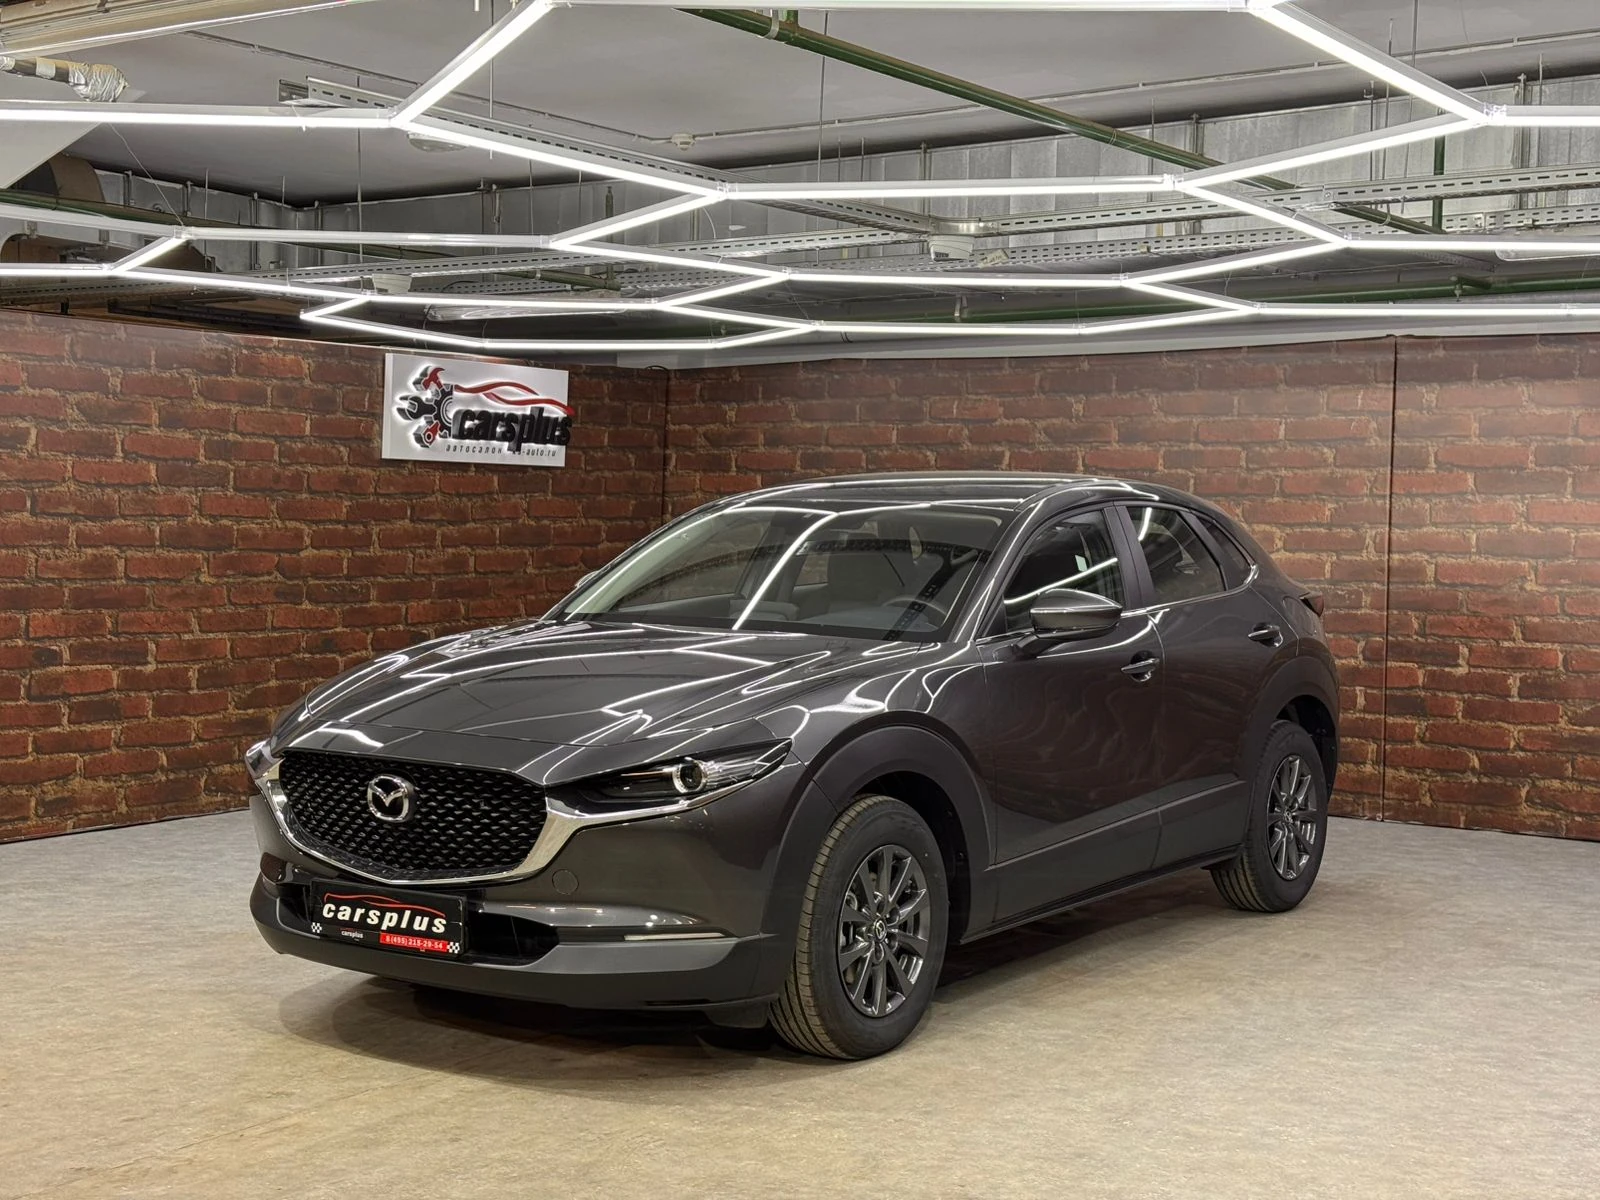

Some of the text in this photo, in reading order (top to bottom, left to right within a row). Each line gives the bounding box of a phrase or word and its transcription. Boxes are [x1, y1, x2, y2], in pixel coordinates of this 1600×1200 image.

[453, 407, 572, 451] carsplus
[446, 444, 503, 454] автосалон
[322, 903, 447, 933] carsplus
[341, 931, 364, 939] carsplus
